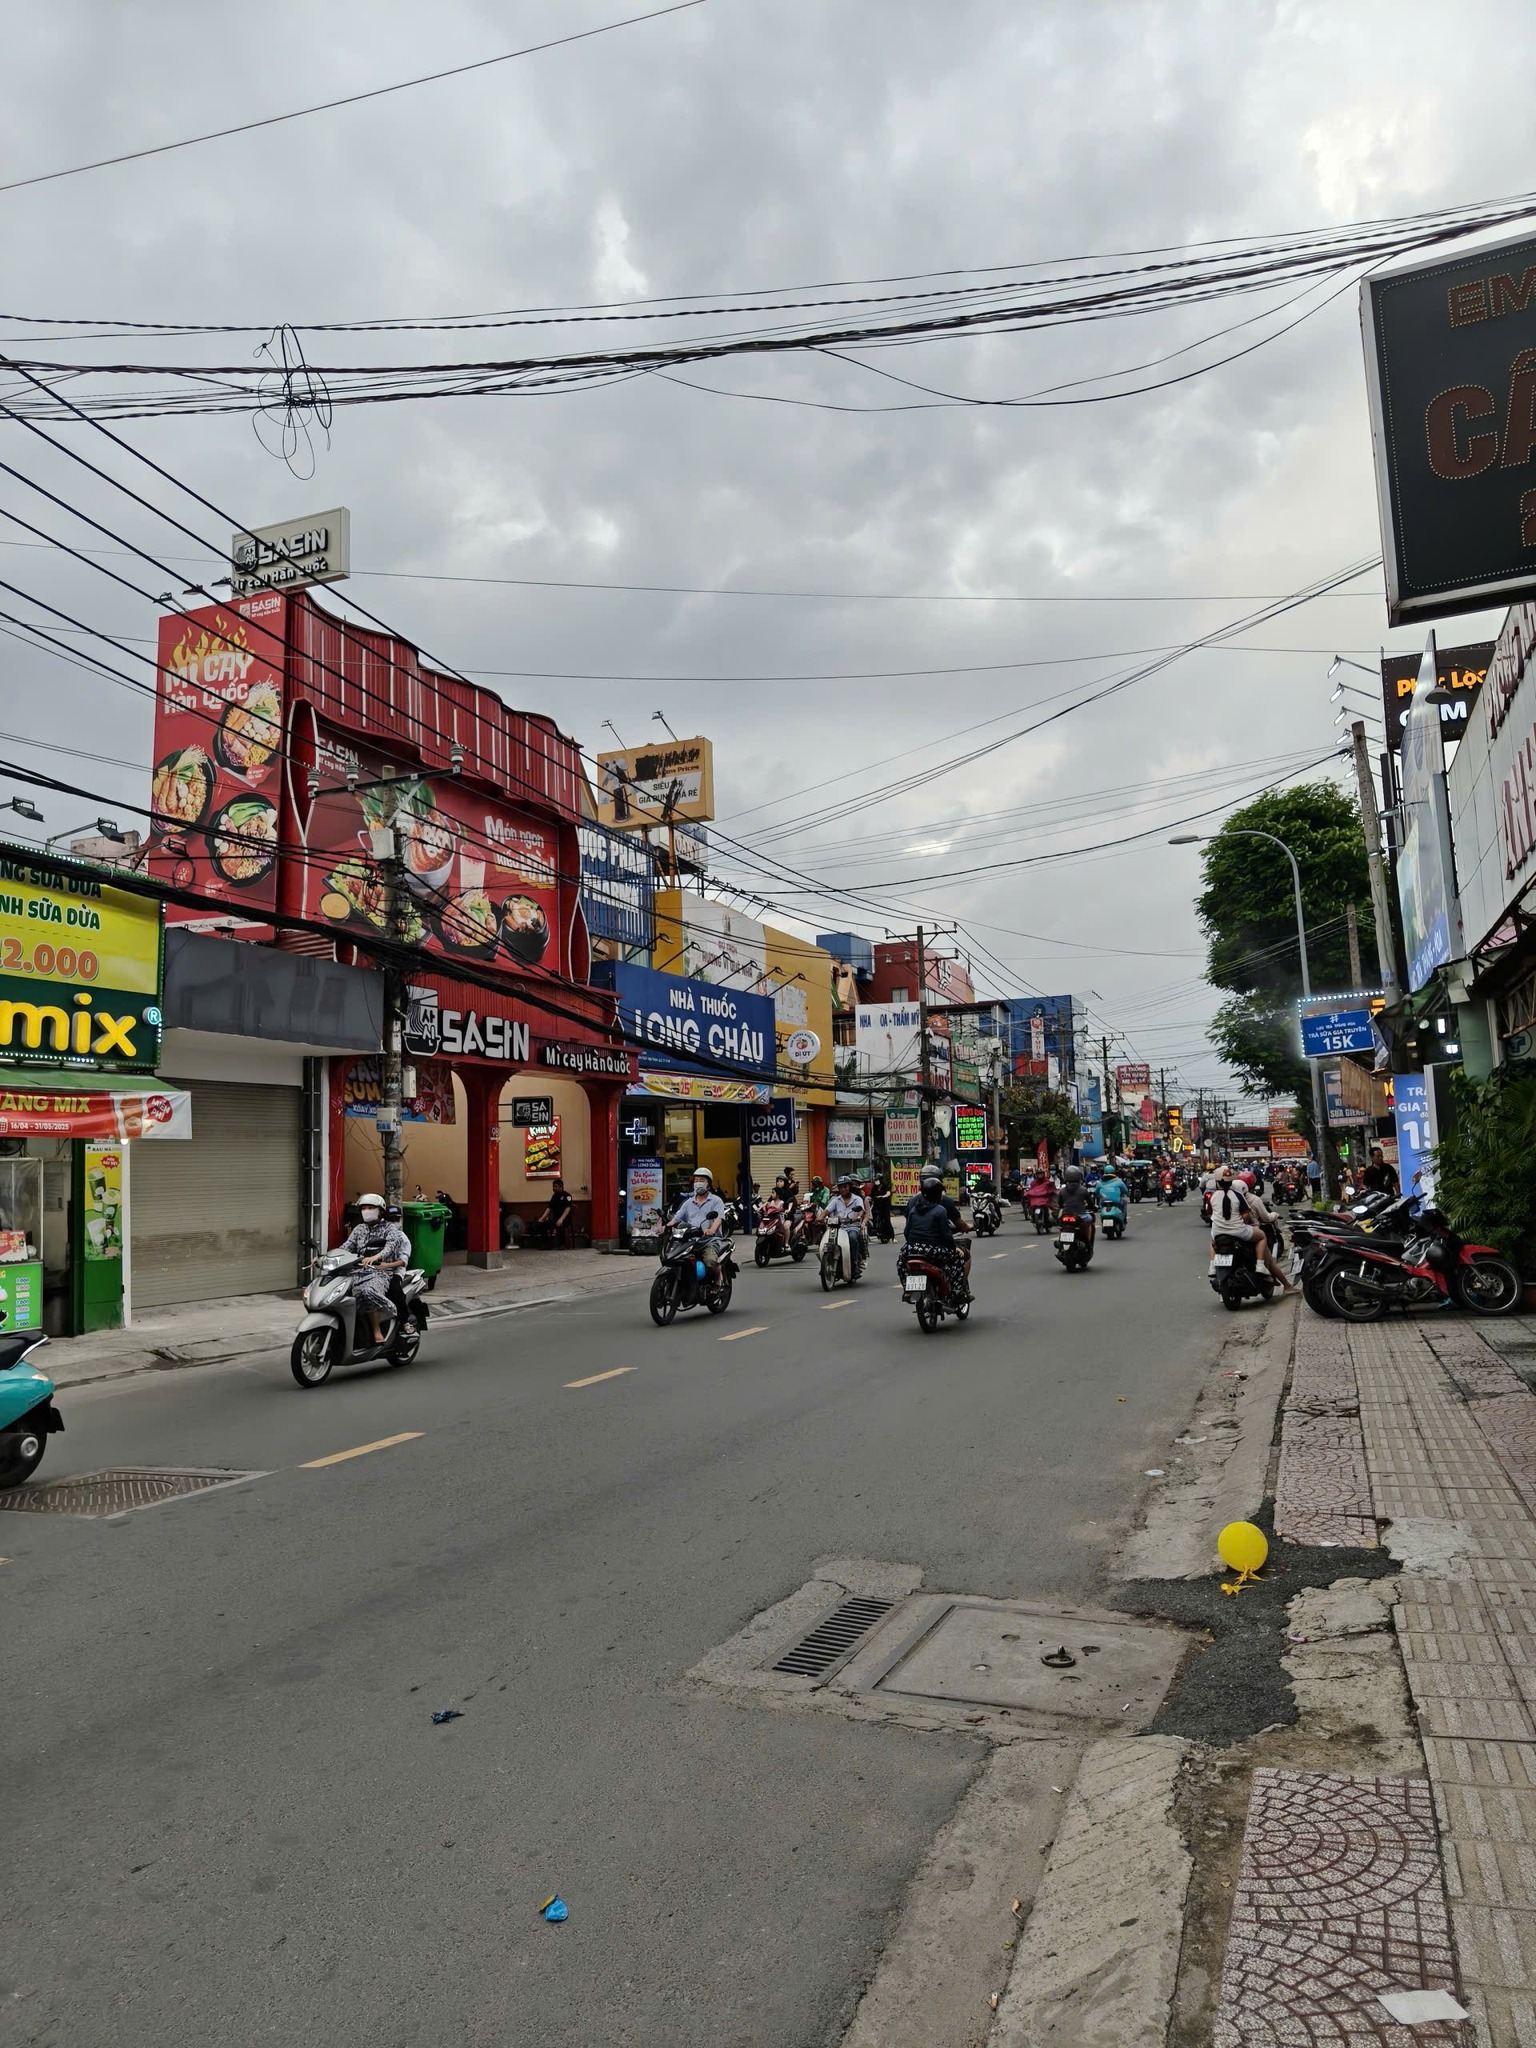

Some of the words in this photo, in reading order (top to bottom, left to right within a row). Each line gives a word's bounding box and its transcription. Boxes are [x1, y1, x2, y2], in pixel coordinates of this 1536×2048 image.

[257, 528, 327, 565] SASIN
[251, 597, 281, 612] SASIN
[203, 650, 254, 682] CAY
[677, 764, 700, 773] Prices
[484, 815, 518, 846] Món
[519, 830, 545, 850] ngon
[28, 897, 62, 923] SỮA
[66, 904, 101, 930] DỪA
[669, 986, 695, 1012] NHÀ
[700, 992, 737, 1020] THUỐC
[859, 1014, 872, 1028] NHA
[441, 1009, 530, 1062] SASIN
[707, 1021, 765, 1065] CHÂU
[1323, 1035, 1354, 1050] 15K
[562, 1055, 584, 1073] cay
[585, 1049, 606, 1072] Hàn
[606, 1053, 632, 1075] Quốc
[54, 1097, 91, 1113] MIX
[532, 1101, 547, 1111] SA
[1398, 1102, 1421, 1112] GIA
[531, 1112, 549, 1122] SIN
[751, 1115, 787, 1127] LONG
[751, 1127, 789, 1143] CHÂU
